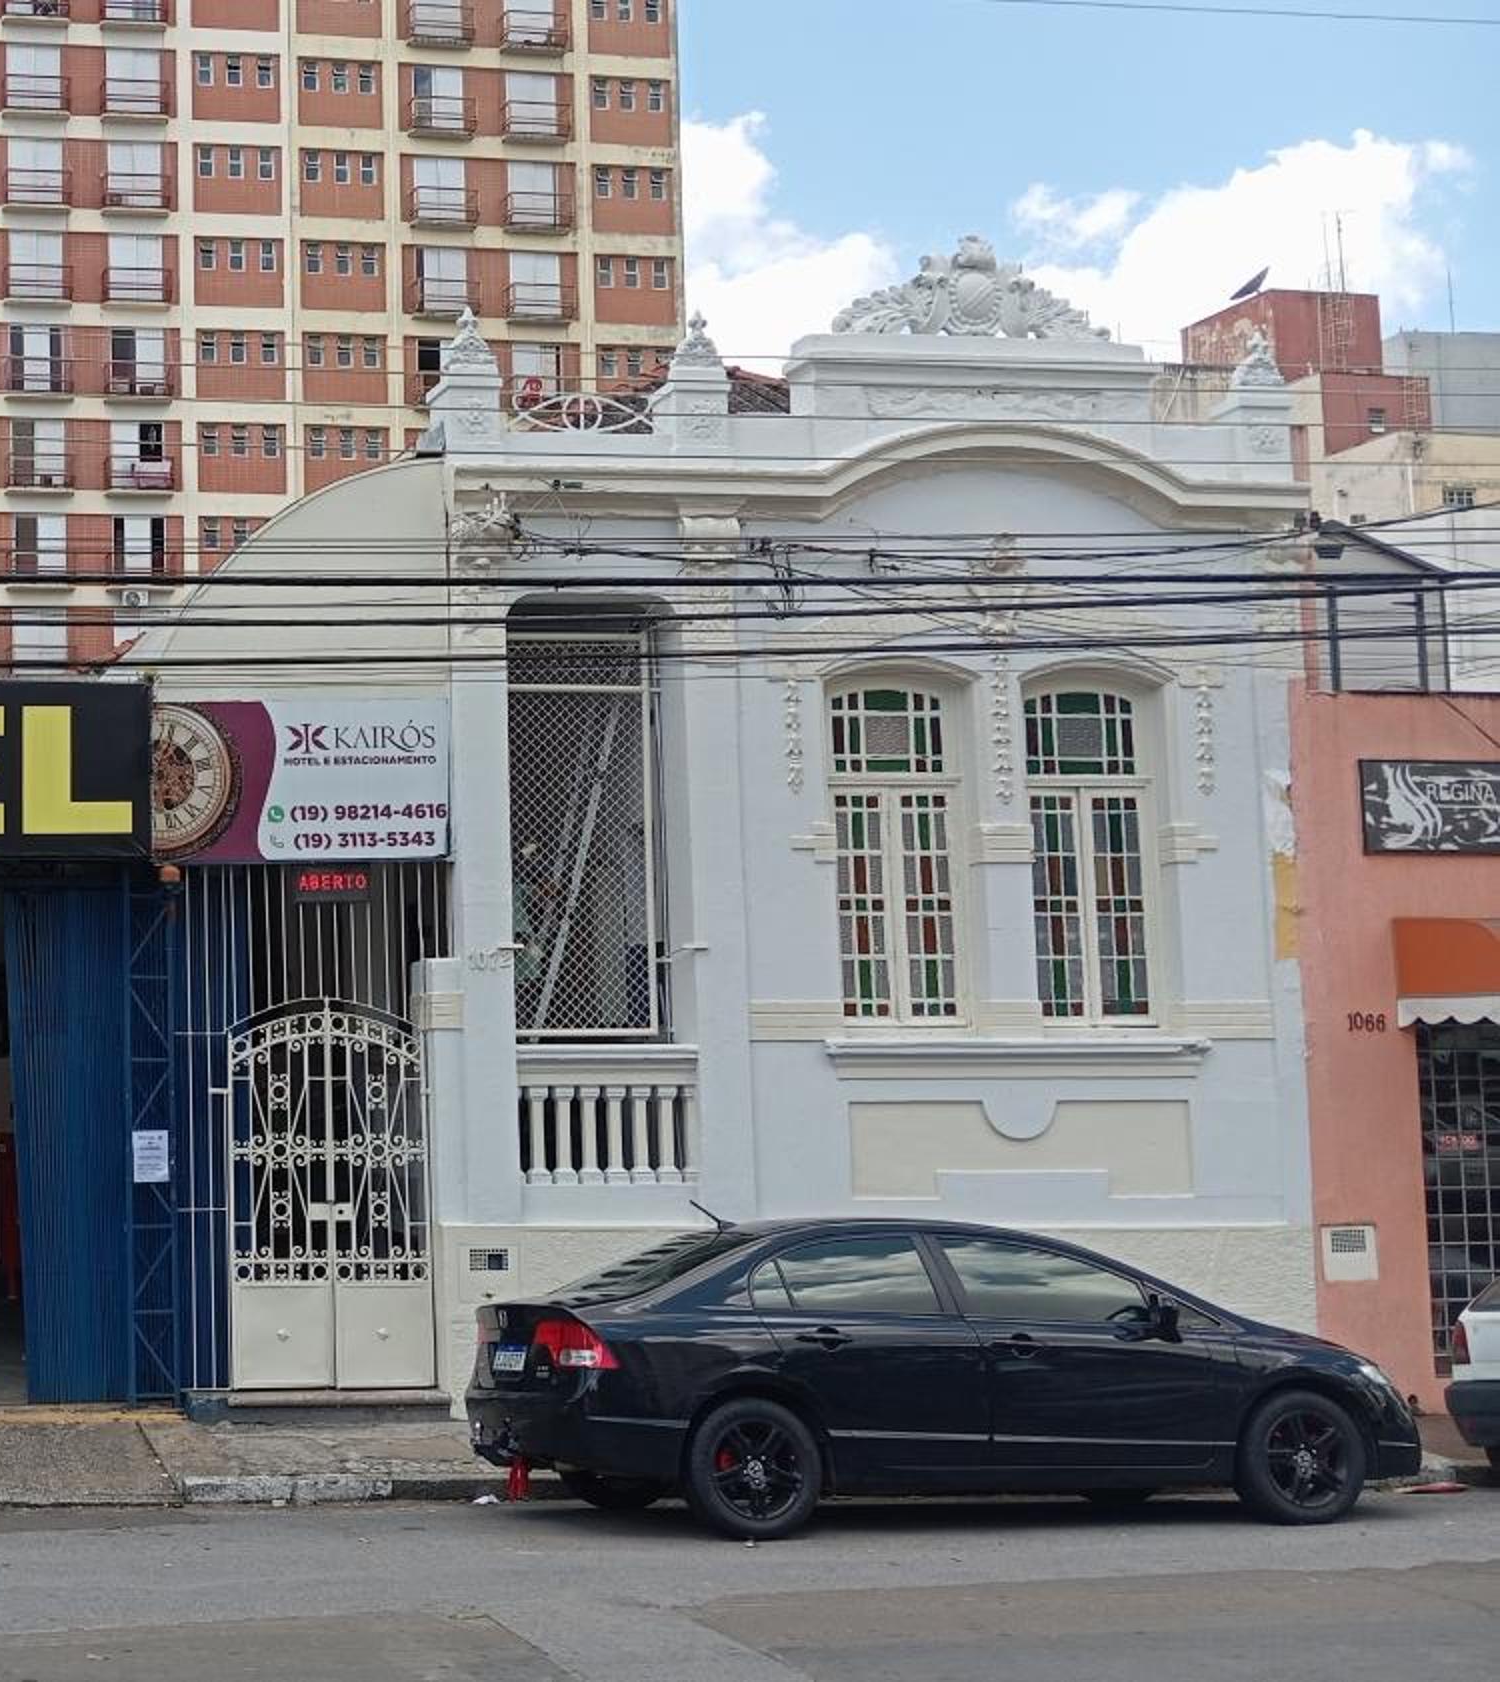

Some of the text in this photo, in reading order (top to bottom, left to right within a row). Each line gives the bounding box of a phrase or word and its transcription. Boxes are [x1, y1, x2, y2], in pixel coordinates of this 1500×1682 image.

[334, 719, 436, 753] KAIRÓS
[284, 755, 437, 767] HOTEL E ESTACIONAMENTO
[1425, 782, 1497, 803] REGINA
[290, 803, 447, 823] (19) 98214-4616
[293, 831, 436, 851] (19) 3113-5343
[299, 873, 368, 891] ABERTO
[1347, 1011, 1386, 1032] 1066
